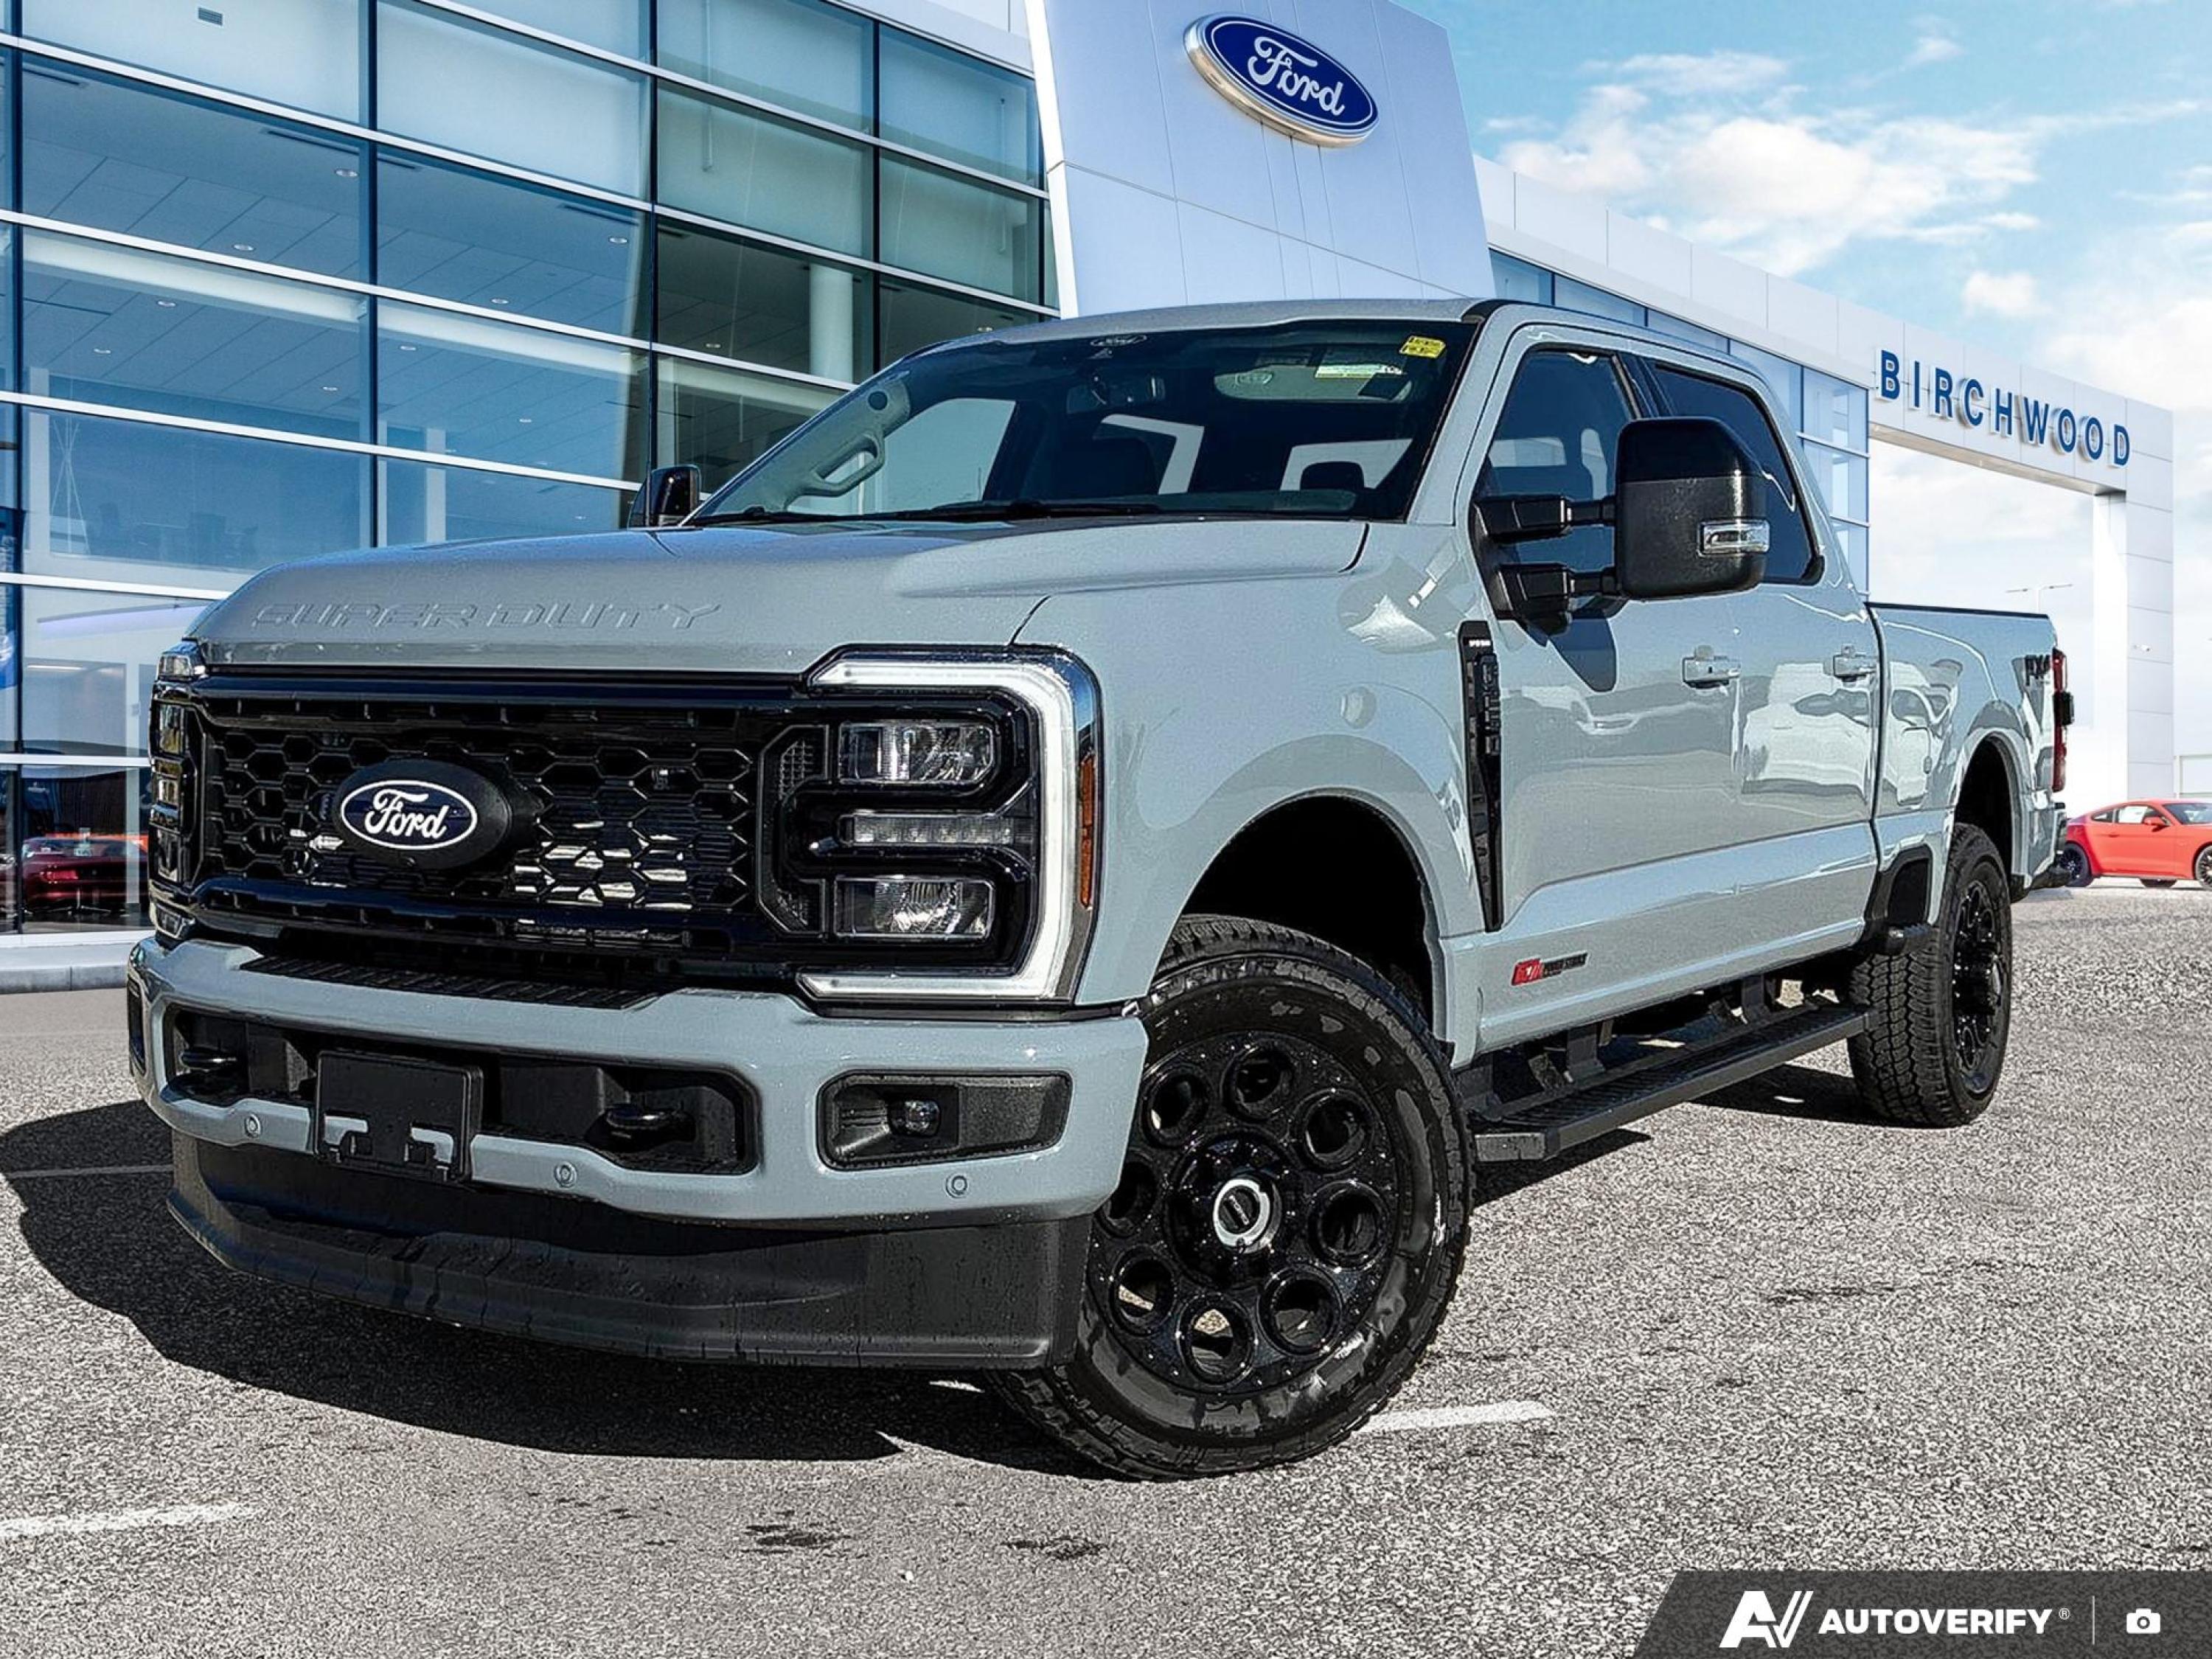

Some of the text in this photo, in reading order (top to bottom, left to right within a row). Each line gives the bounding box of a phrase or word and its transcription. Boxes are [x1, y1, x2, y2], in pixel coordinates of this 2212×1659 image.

[1248, 36, 1345, 116] Ford
[1879, 349, 2131, 467] BIRCHWOOD
[251, 602, 722, 629] SUPER DUTY
[364, 788, 450, 839] Ford
